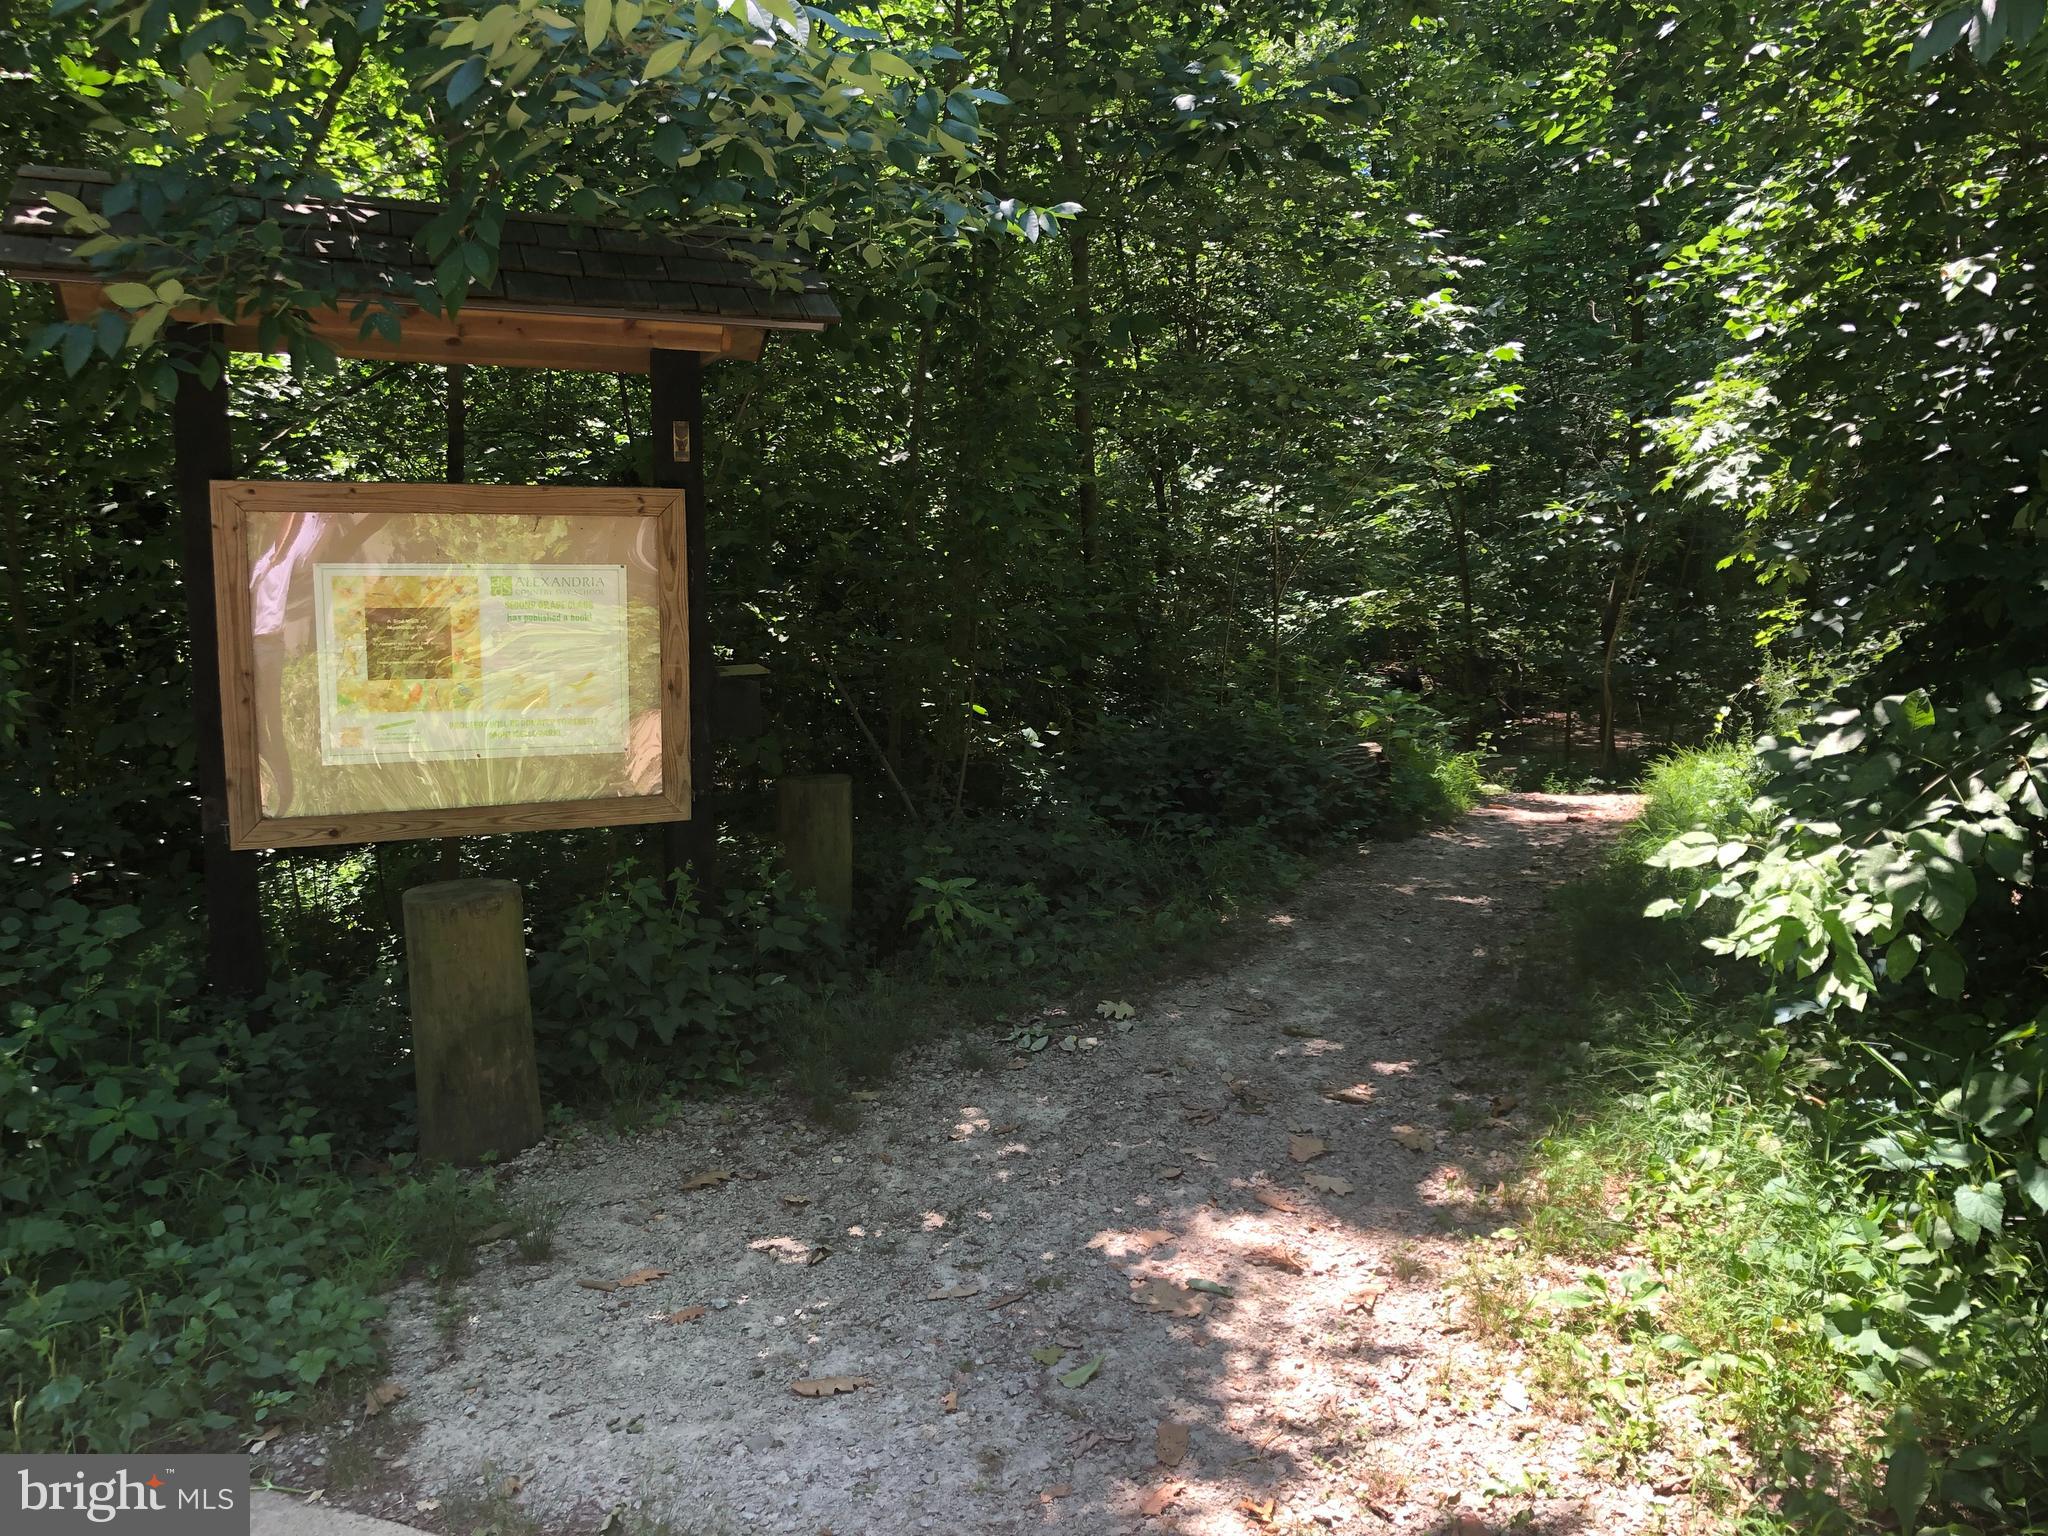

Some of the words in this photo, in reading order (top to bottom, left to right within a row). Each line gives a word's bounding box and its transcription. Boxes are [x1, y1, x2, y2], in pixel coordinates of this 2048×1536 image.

[515, 576, 605, 588] ALEXANDRIA
[507, 612, 522, 622] has
[524, 612, 561, 624] published
